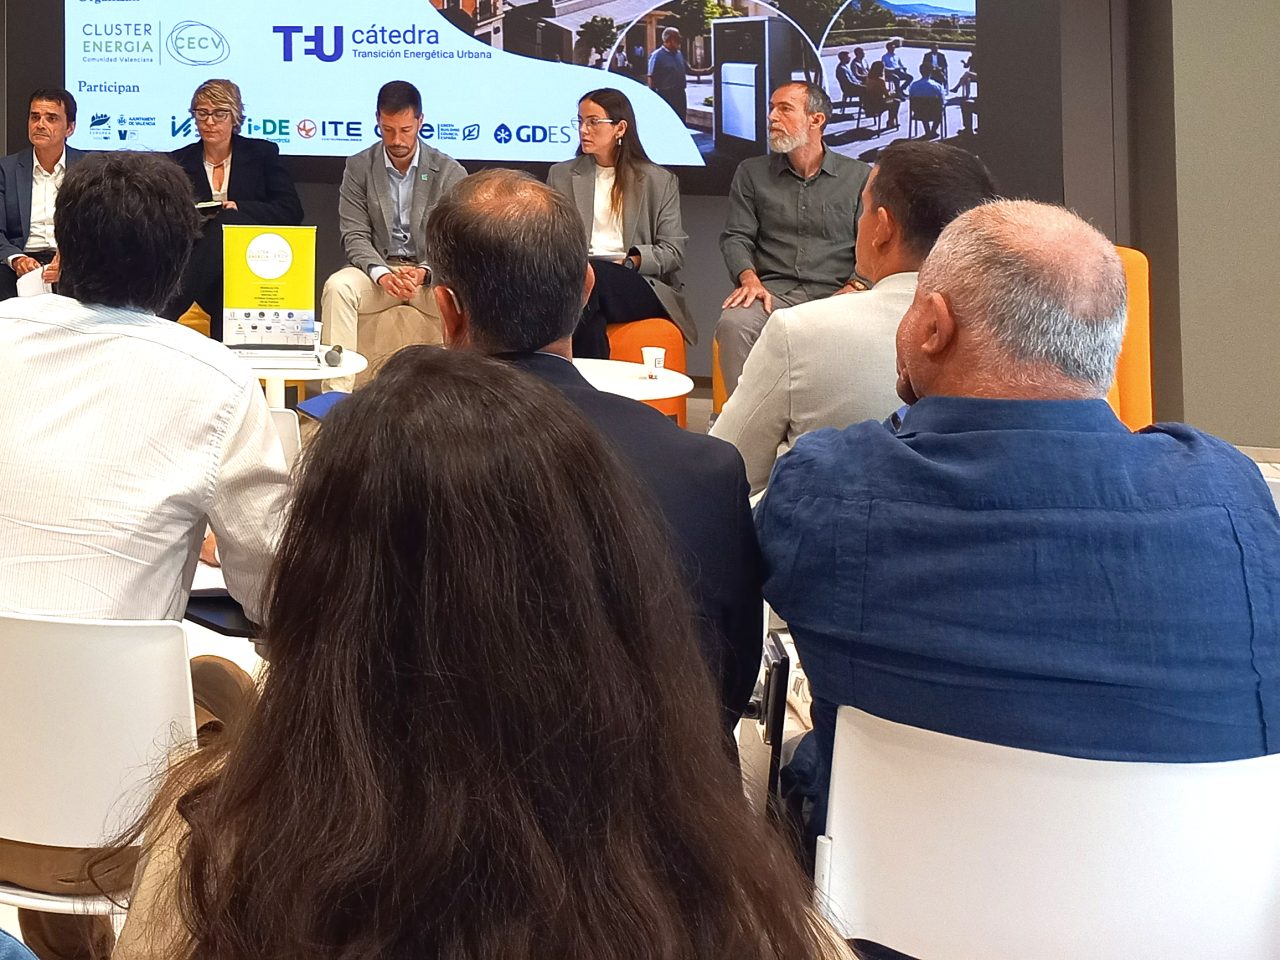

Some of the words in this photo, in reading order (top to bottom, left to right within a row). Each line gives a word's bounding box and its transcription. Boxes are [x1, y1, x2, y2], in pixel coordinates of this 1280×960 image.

[83, 24, 151, 35] CLUSTER
[352, 24, 438, 44] cátedra
[83, 41, 153, 53] ENERGIA
[352, 49, 401, 59] Transición
[404, 49, 454, 60] Energética
[457, 49, 492, 59] Urbana
[78, 81, 139, 94] Participan
[322, 121, 362, 136] ITE
[516, 125, 570, 143] GDES
